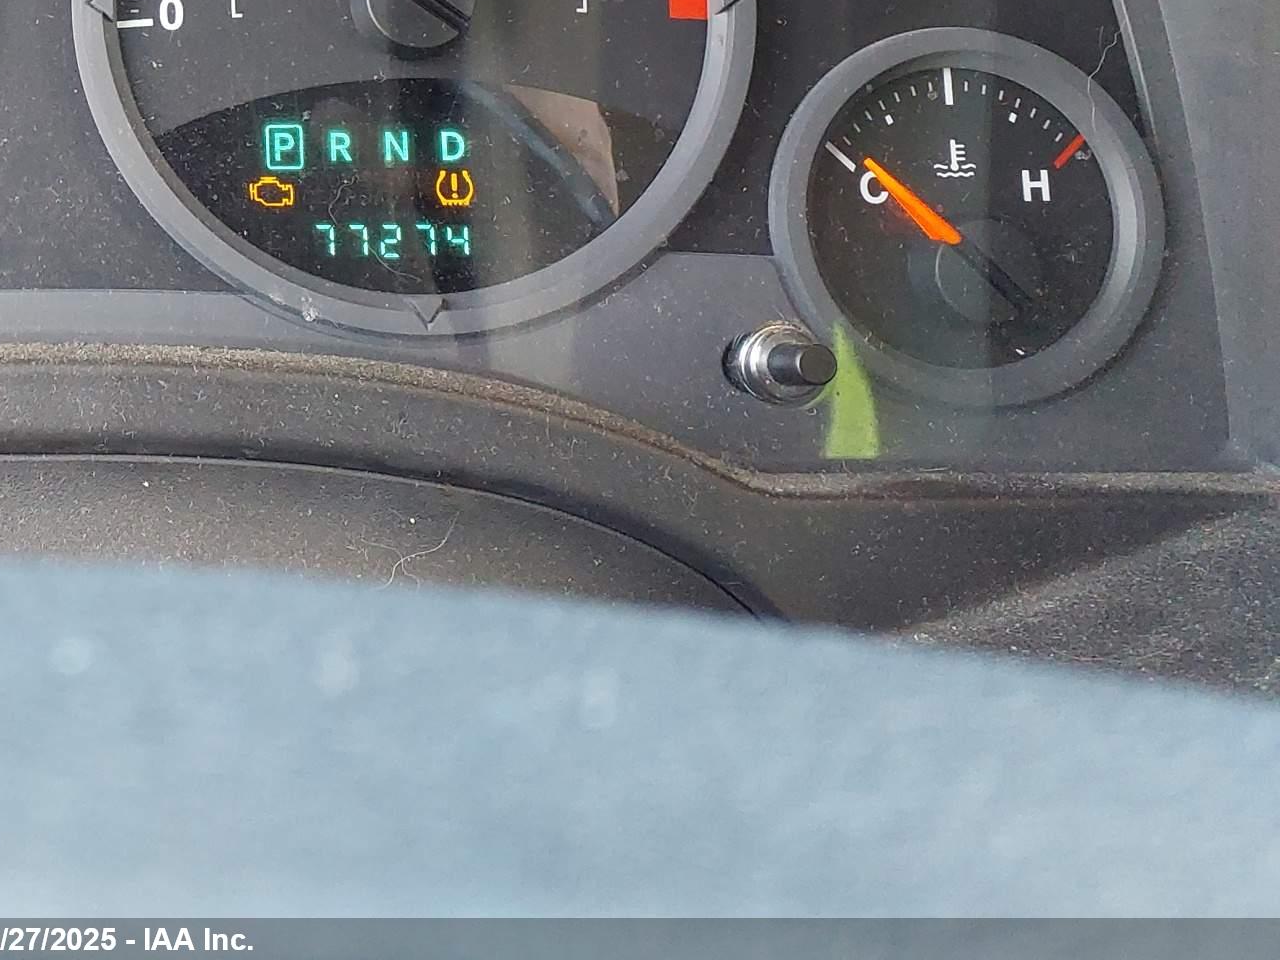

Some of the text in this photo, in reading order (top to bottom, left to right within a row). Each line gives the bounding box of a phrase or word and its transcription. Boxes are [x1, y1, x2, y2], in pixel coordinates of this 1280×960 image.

[274, 131, 465, 161] P R N D
[859, 171, 889, 205] C
[1021, 169, 1051, 202] H
[315, 224, 470, 258] 77274
